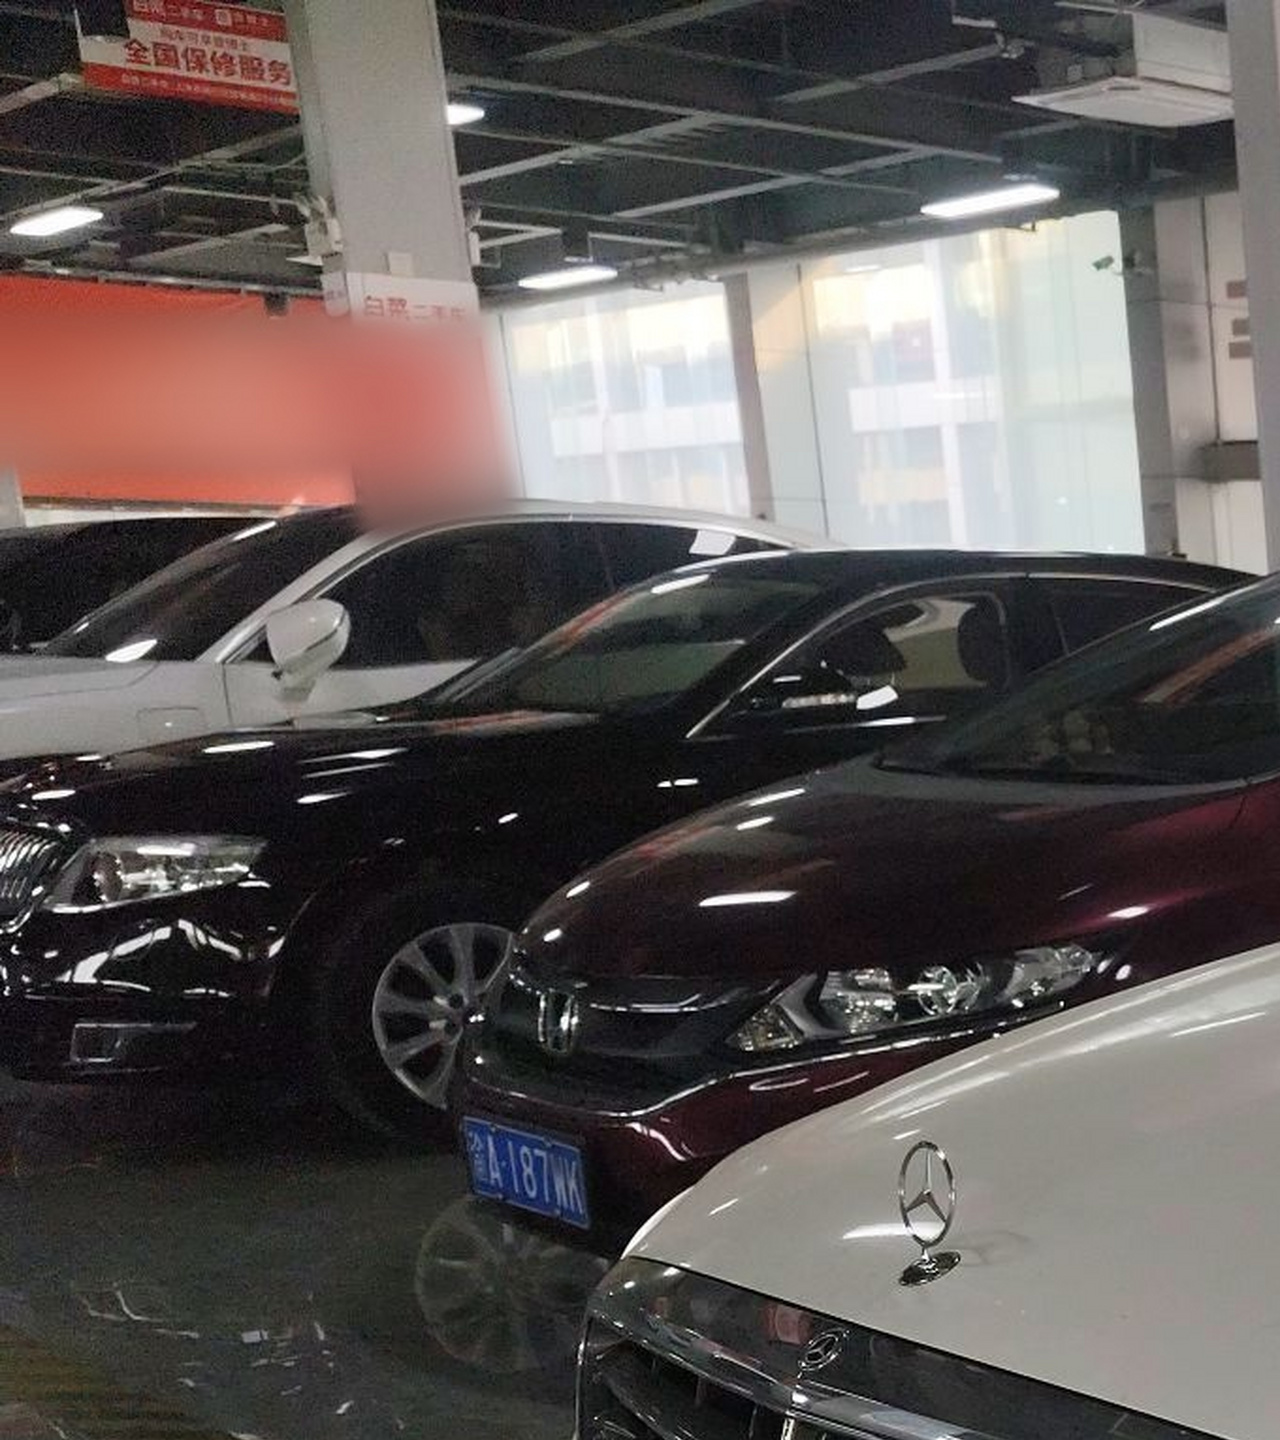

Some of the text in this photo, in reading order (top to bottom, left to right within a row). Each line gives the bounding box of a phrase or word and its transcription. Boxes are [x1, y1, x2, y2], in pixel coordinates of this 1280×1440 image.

[124, 38, 292, 86] 全国保修服务
